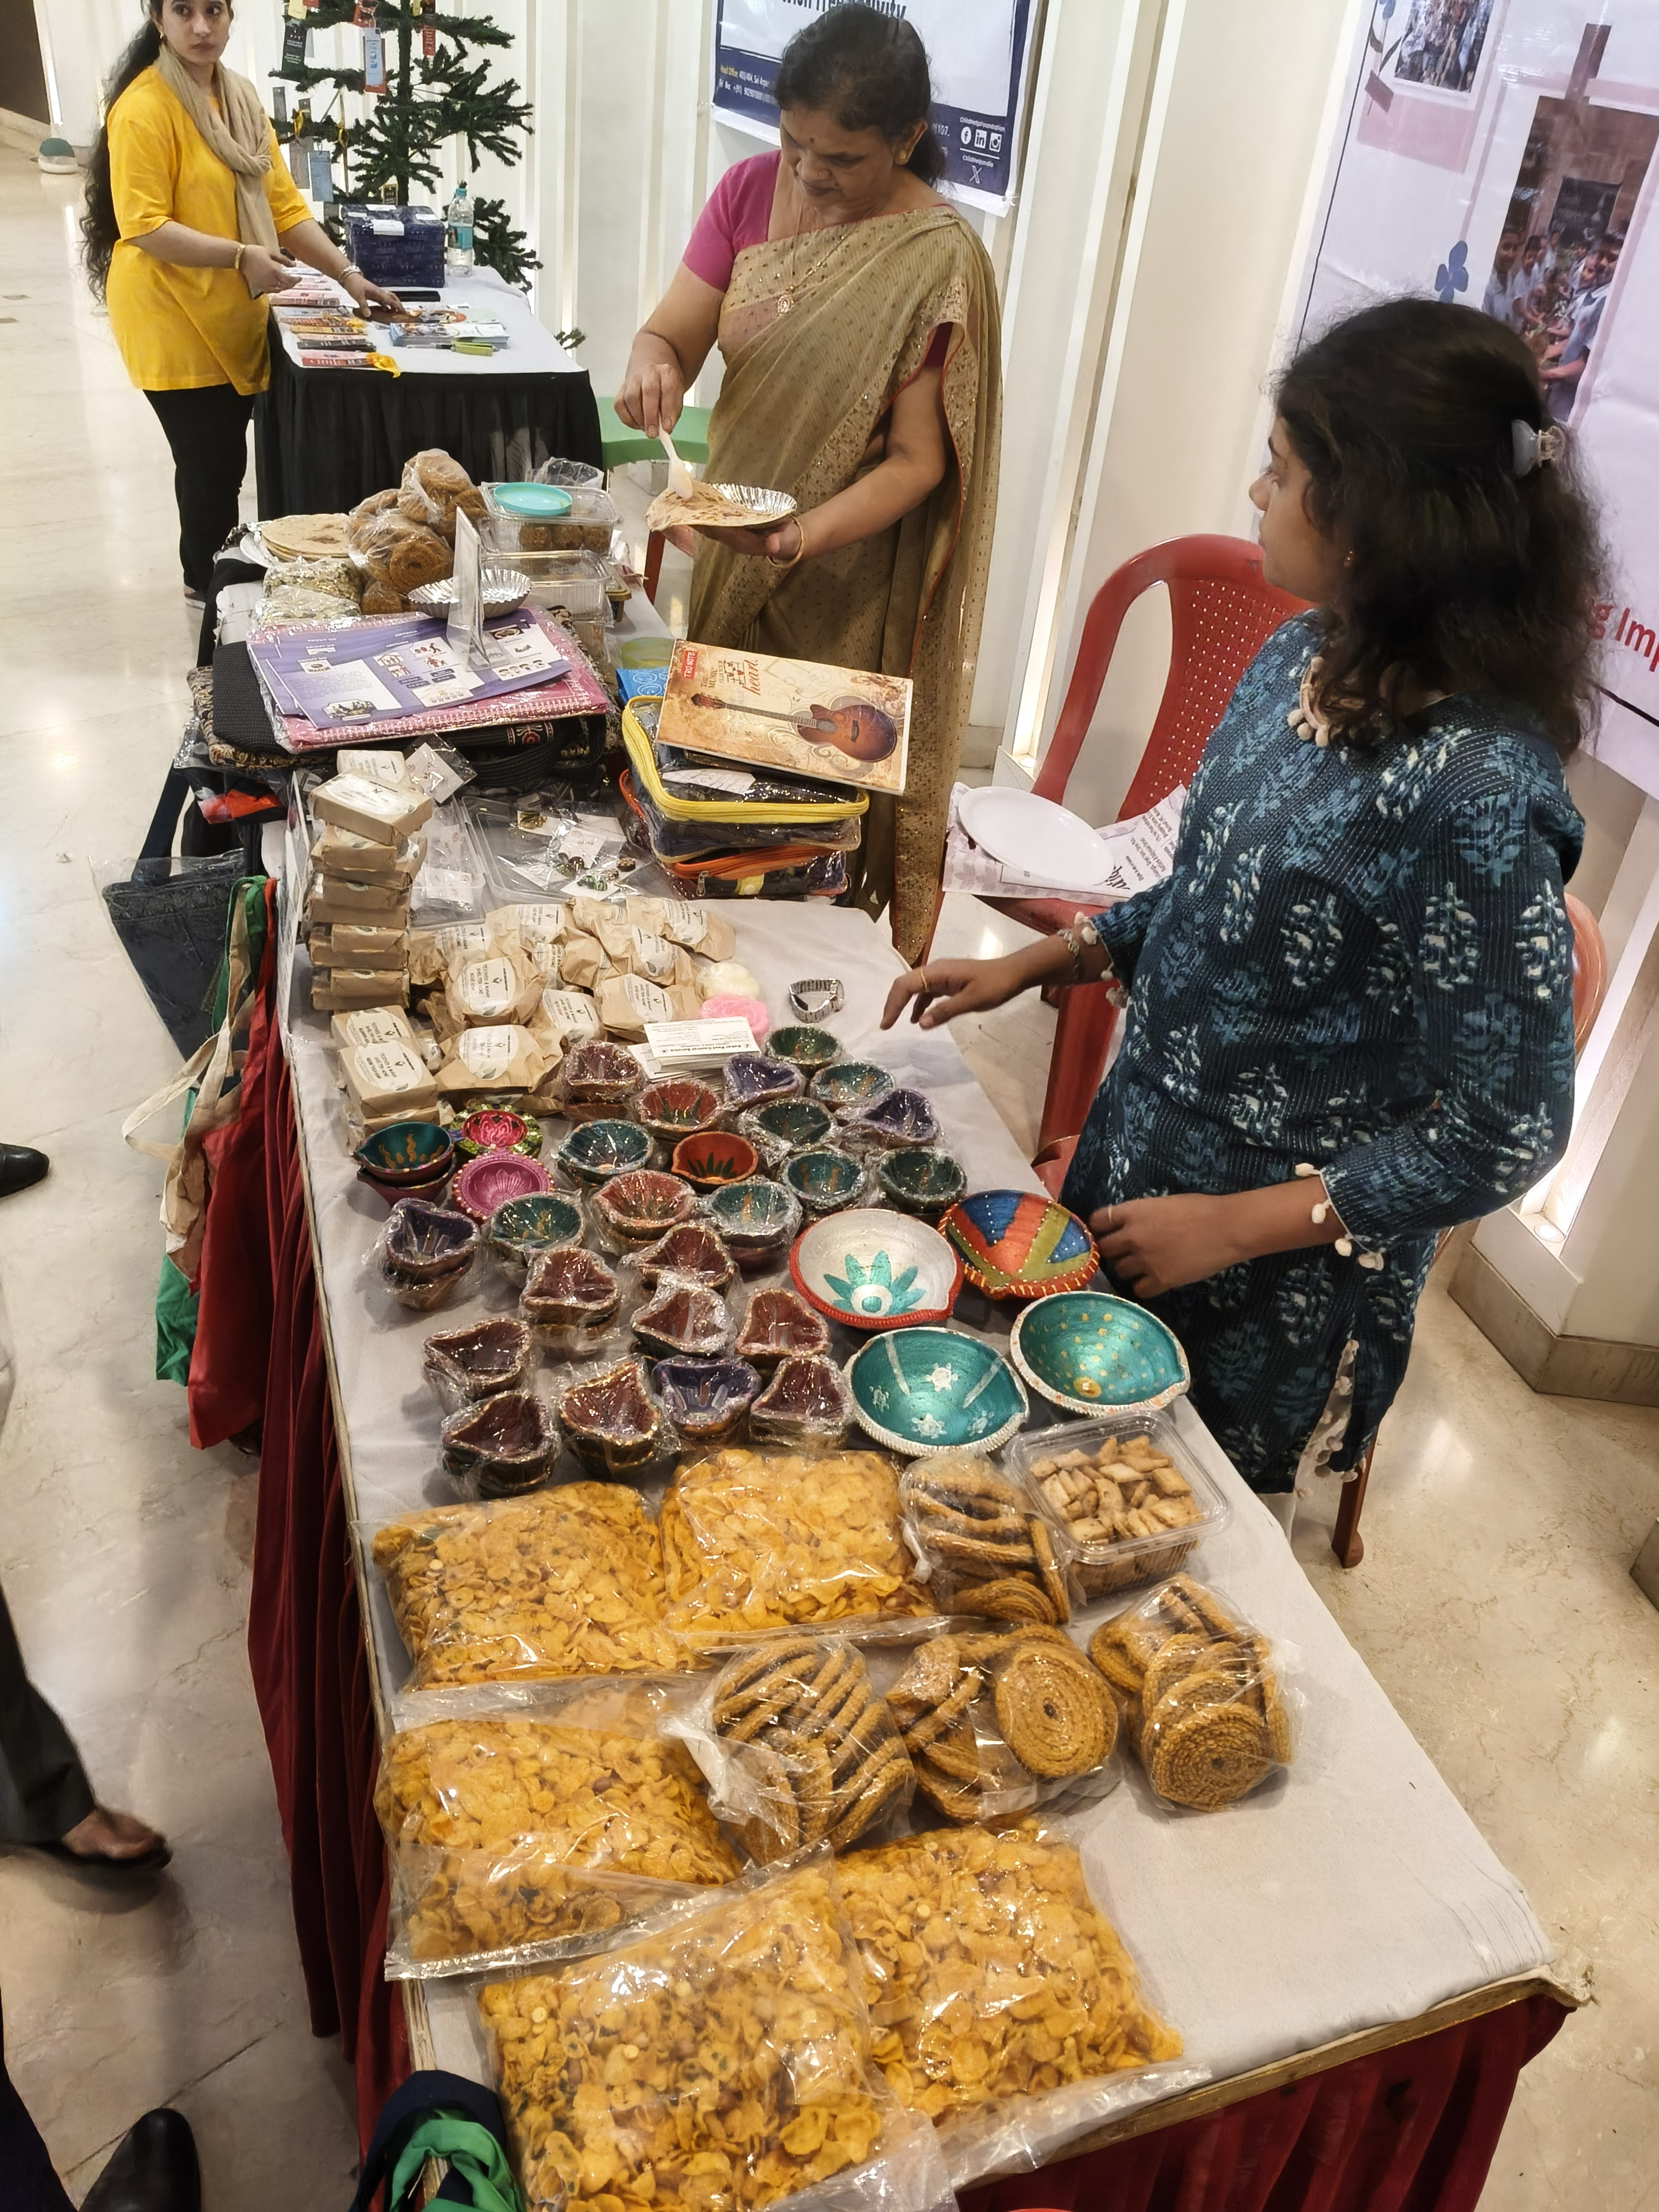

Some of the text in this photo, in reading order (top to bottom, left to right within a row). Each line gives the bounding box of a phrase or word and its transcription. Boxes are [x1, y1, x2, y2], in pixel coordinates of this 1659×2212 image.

[684, 651, 696, 678] TRU NOTE
[700, 676, 709, 687] THE
[709, 667, 718, 689] MUSIC
